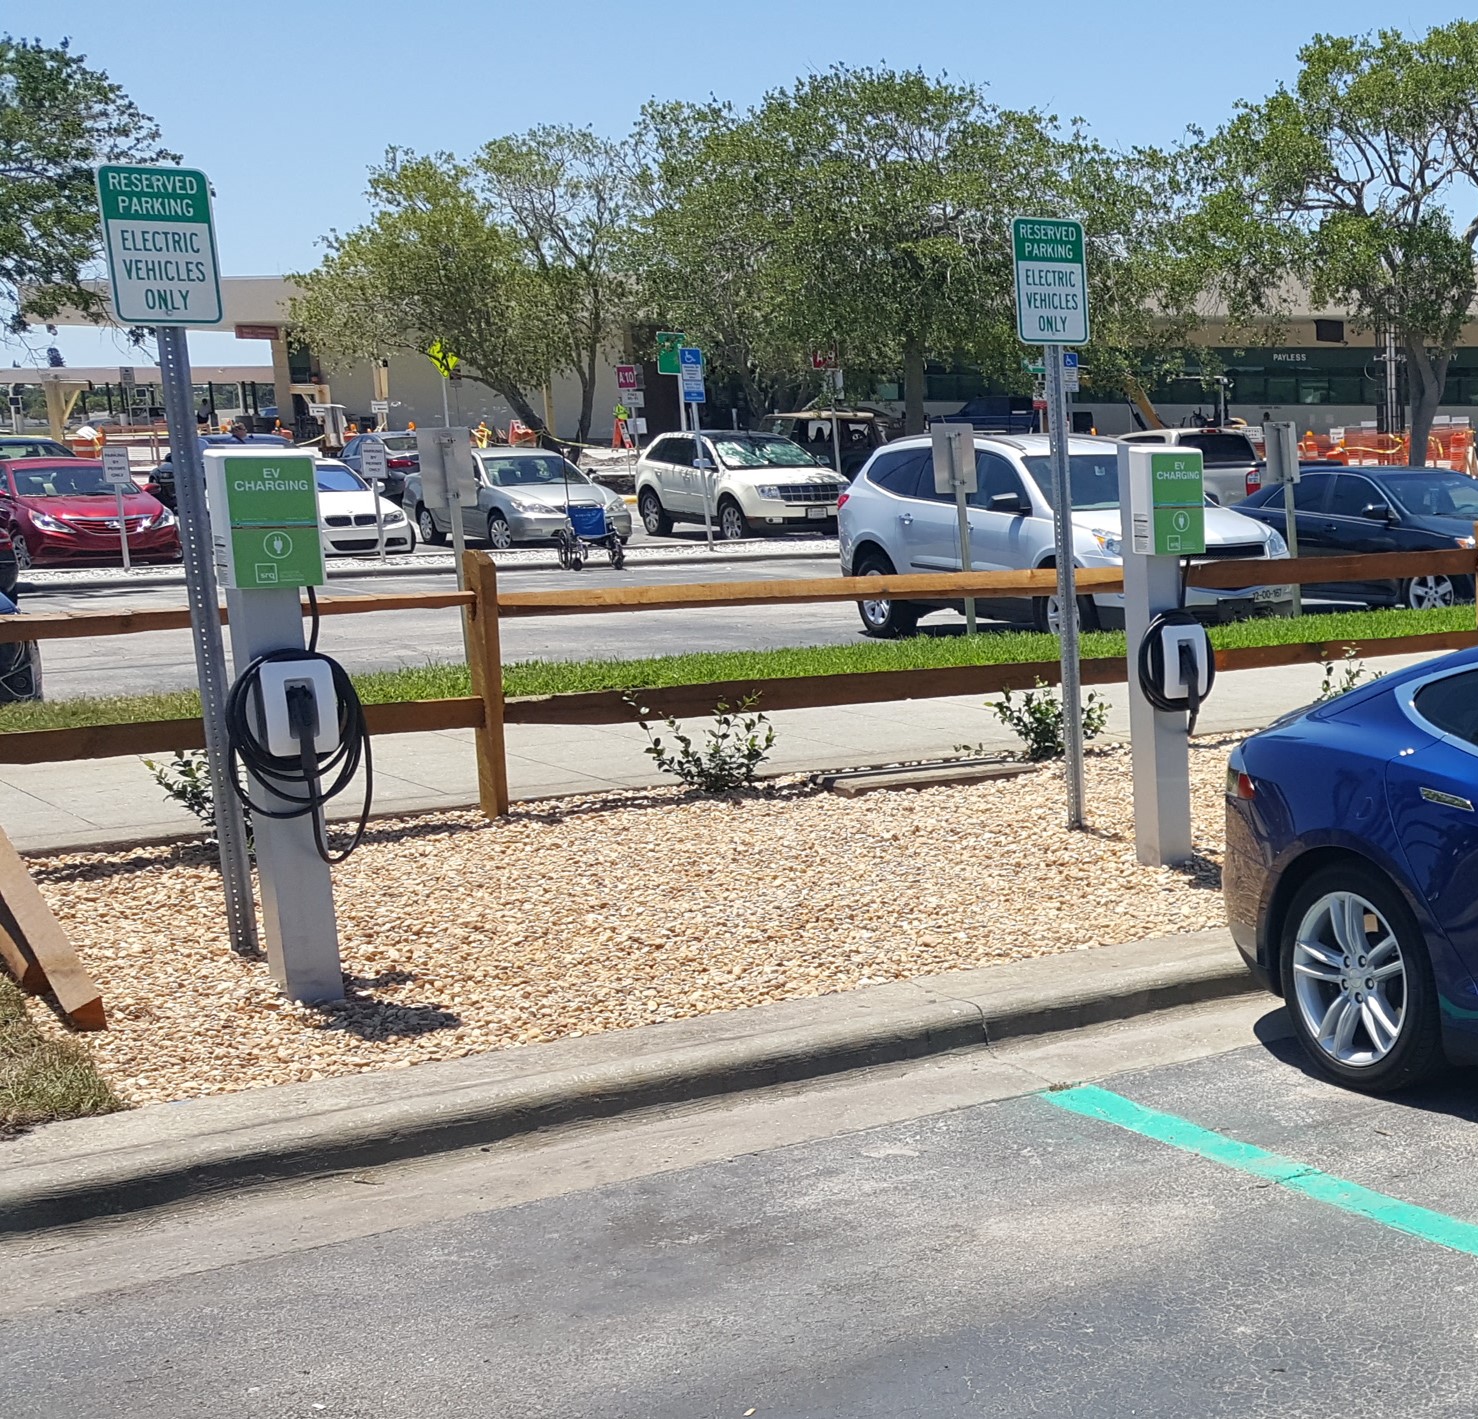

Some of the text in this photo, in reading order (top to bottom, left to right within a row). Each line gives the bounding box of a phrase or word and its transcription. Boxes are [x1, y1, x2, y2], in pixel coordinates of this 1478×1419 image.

[108, 172, 197, 194] RESERVED
[117, 196, 194, 216] PARKING
[1019, 224, 1076, 241] RESERVED
[121, 229, 201, 254] ELECTRIC
[1024, 242, 1073, 259] PARKING
[122, 258, 206, 283] VEHICLES
[1025, 268, 1076, 288] ELECTRIC
[144, 288, 190, 310] ONLY
[1026, 292, 1078, 310] VEHICLES
[1038, 315, 1067, 333] ONLY
[1273, 353, 1307, 361] PAYLESS
[263, 468, 280, 478] EV
[1174, 462, 1185, 470] EV
[1157, 471, 1200, 480] CHARGING
[234, 480, 309, 491] CHARGING
[260, 572, 276, 580] srq
